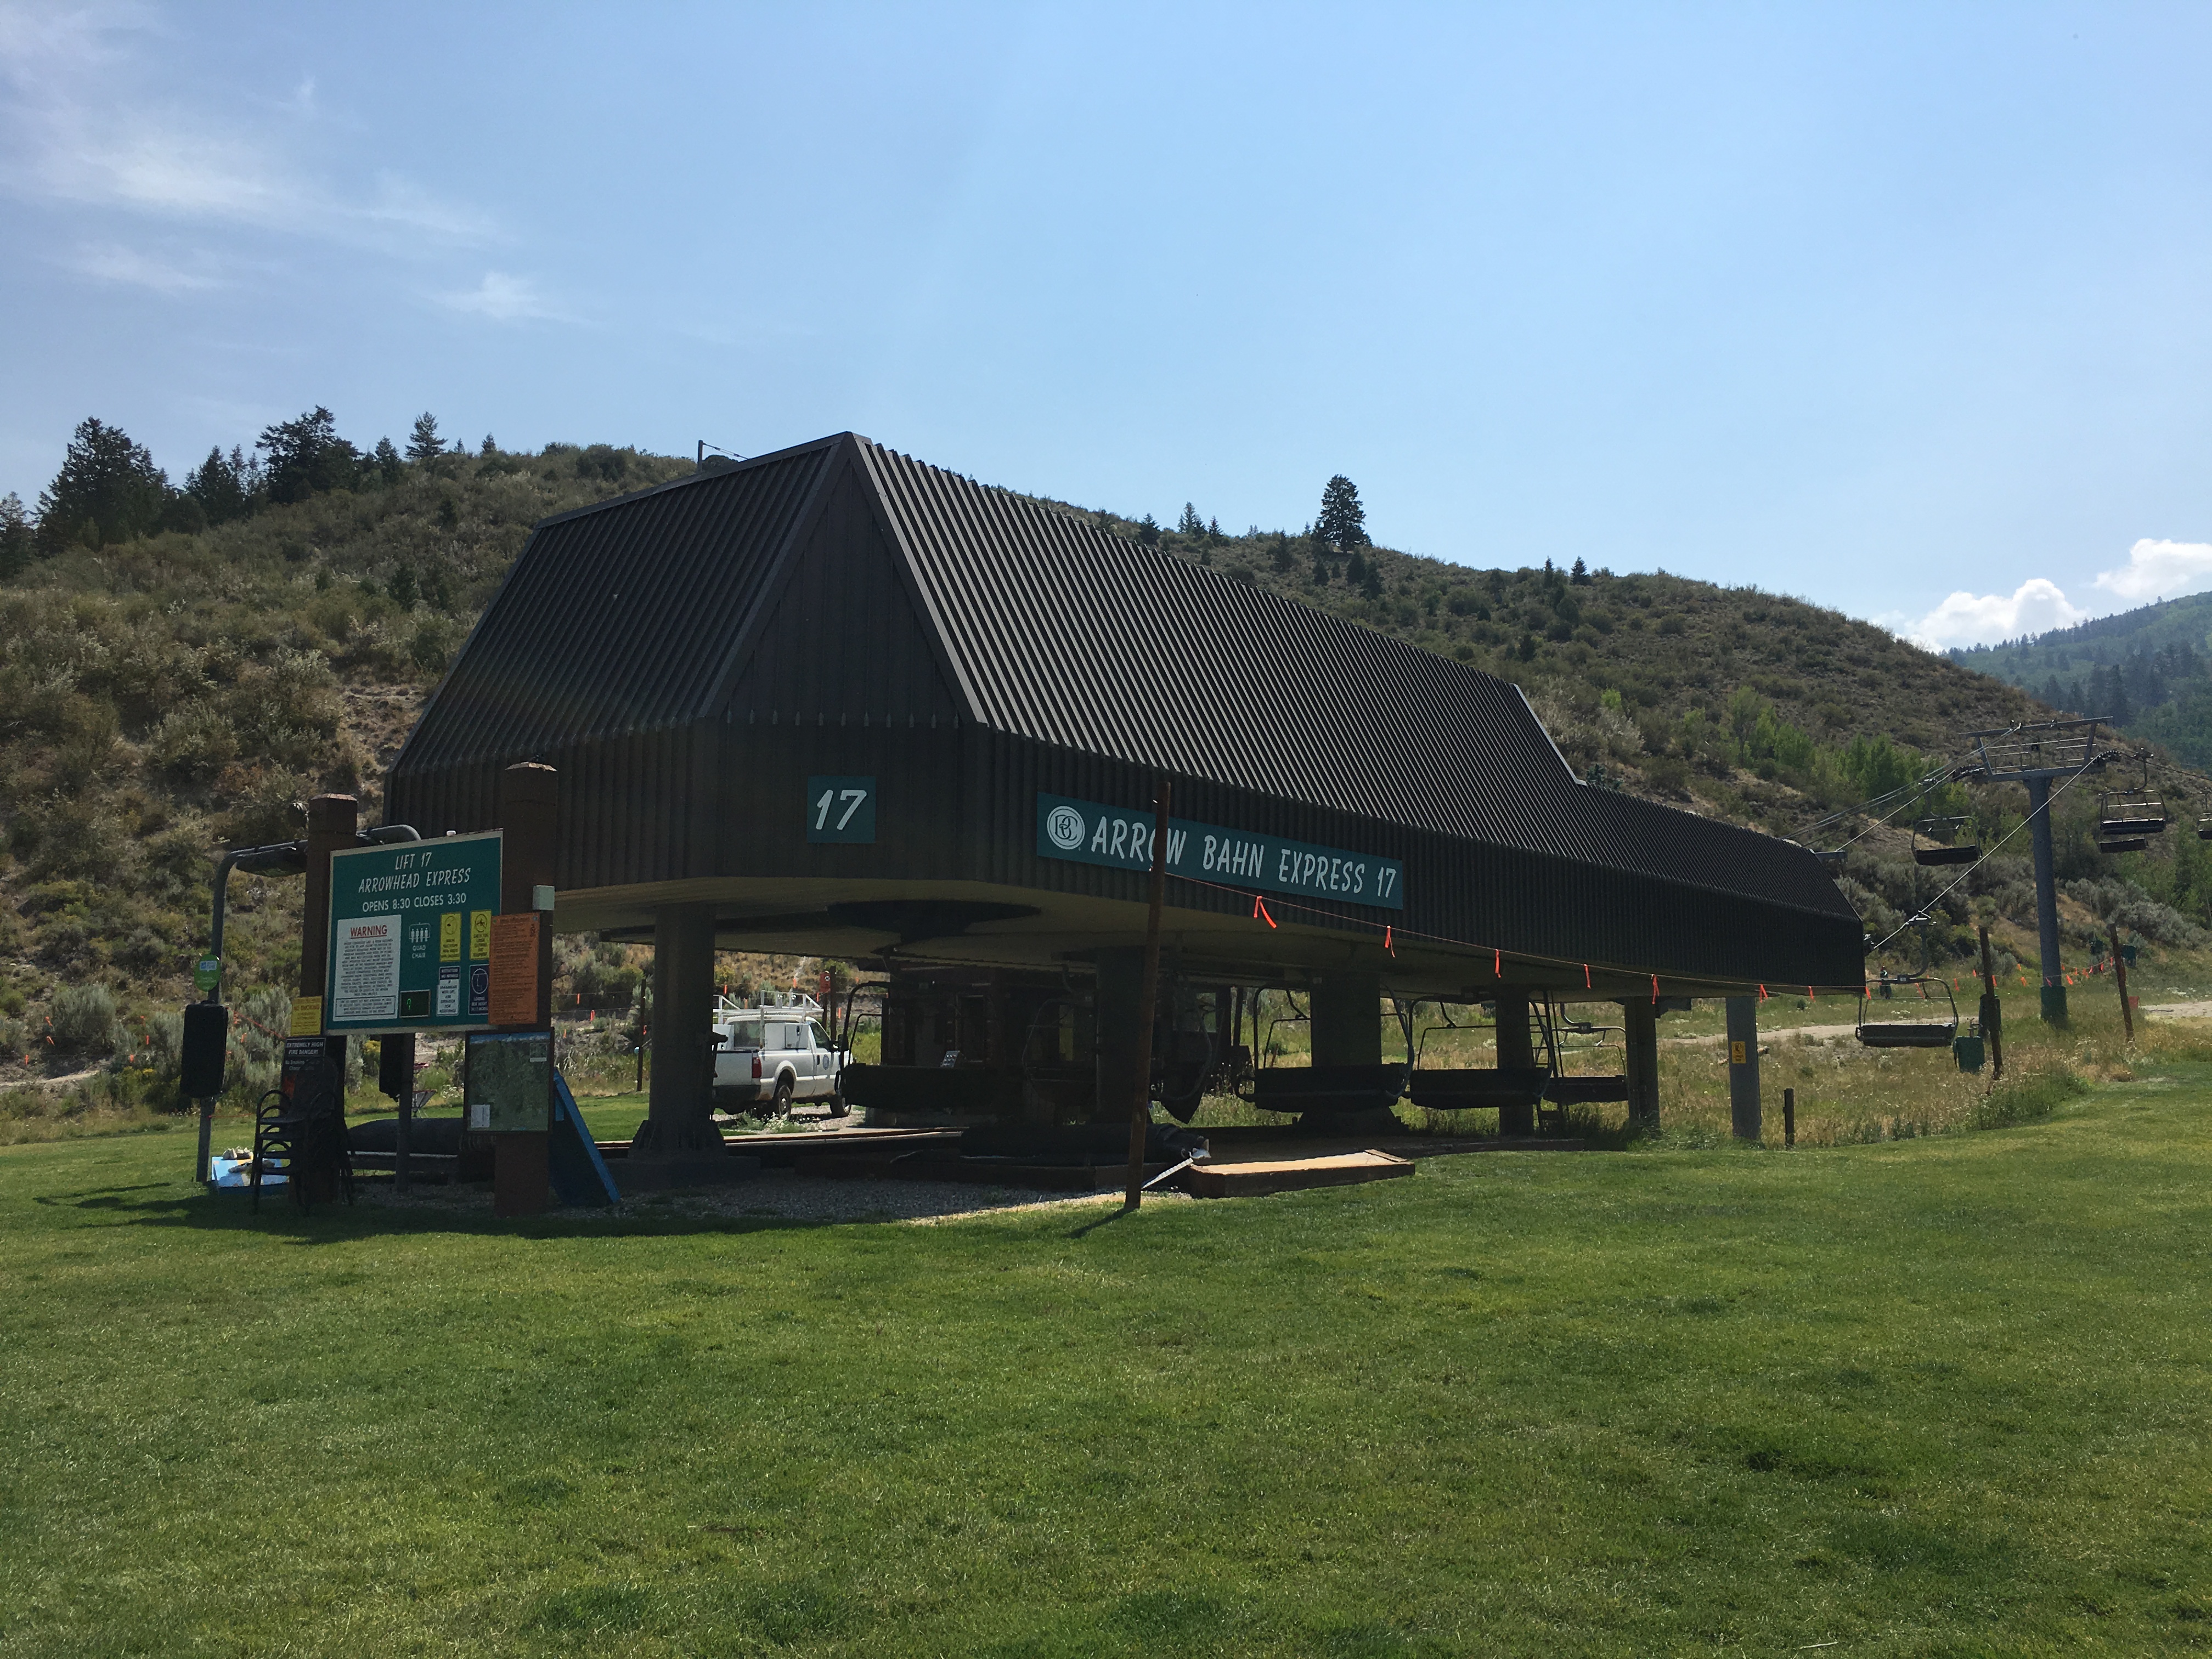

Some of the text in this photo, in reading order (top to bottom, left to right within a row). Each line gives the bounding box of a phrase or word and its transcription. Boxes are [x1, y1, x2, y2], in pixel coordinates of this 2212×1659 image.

[816, 789, 867, 830] 17
[394, 852, 432, 870] LIFT 17
[1203, 835, 1264, 878] BAHN
[1278, 849, 1365, 893] EXPRESS
[1377, 867, 1397, 898] 17
[358, 867, 471, 893] ARROWHEAD EXPRESS
[362, 893, 466, 912] OPENS 8:30 CLOSES 3:30
[350, 924, 387, 937] WARNING
